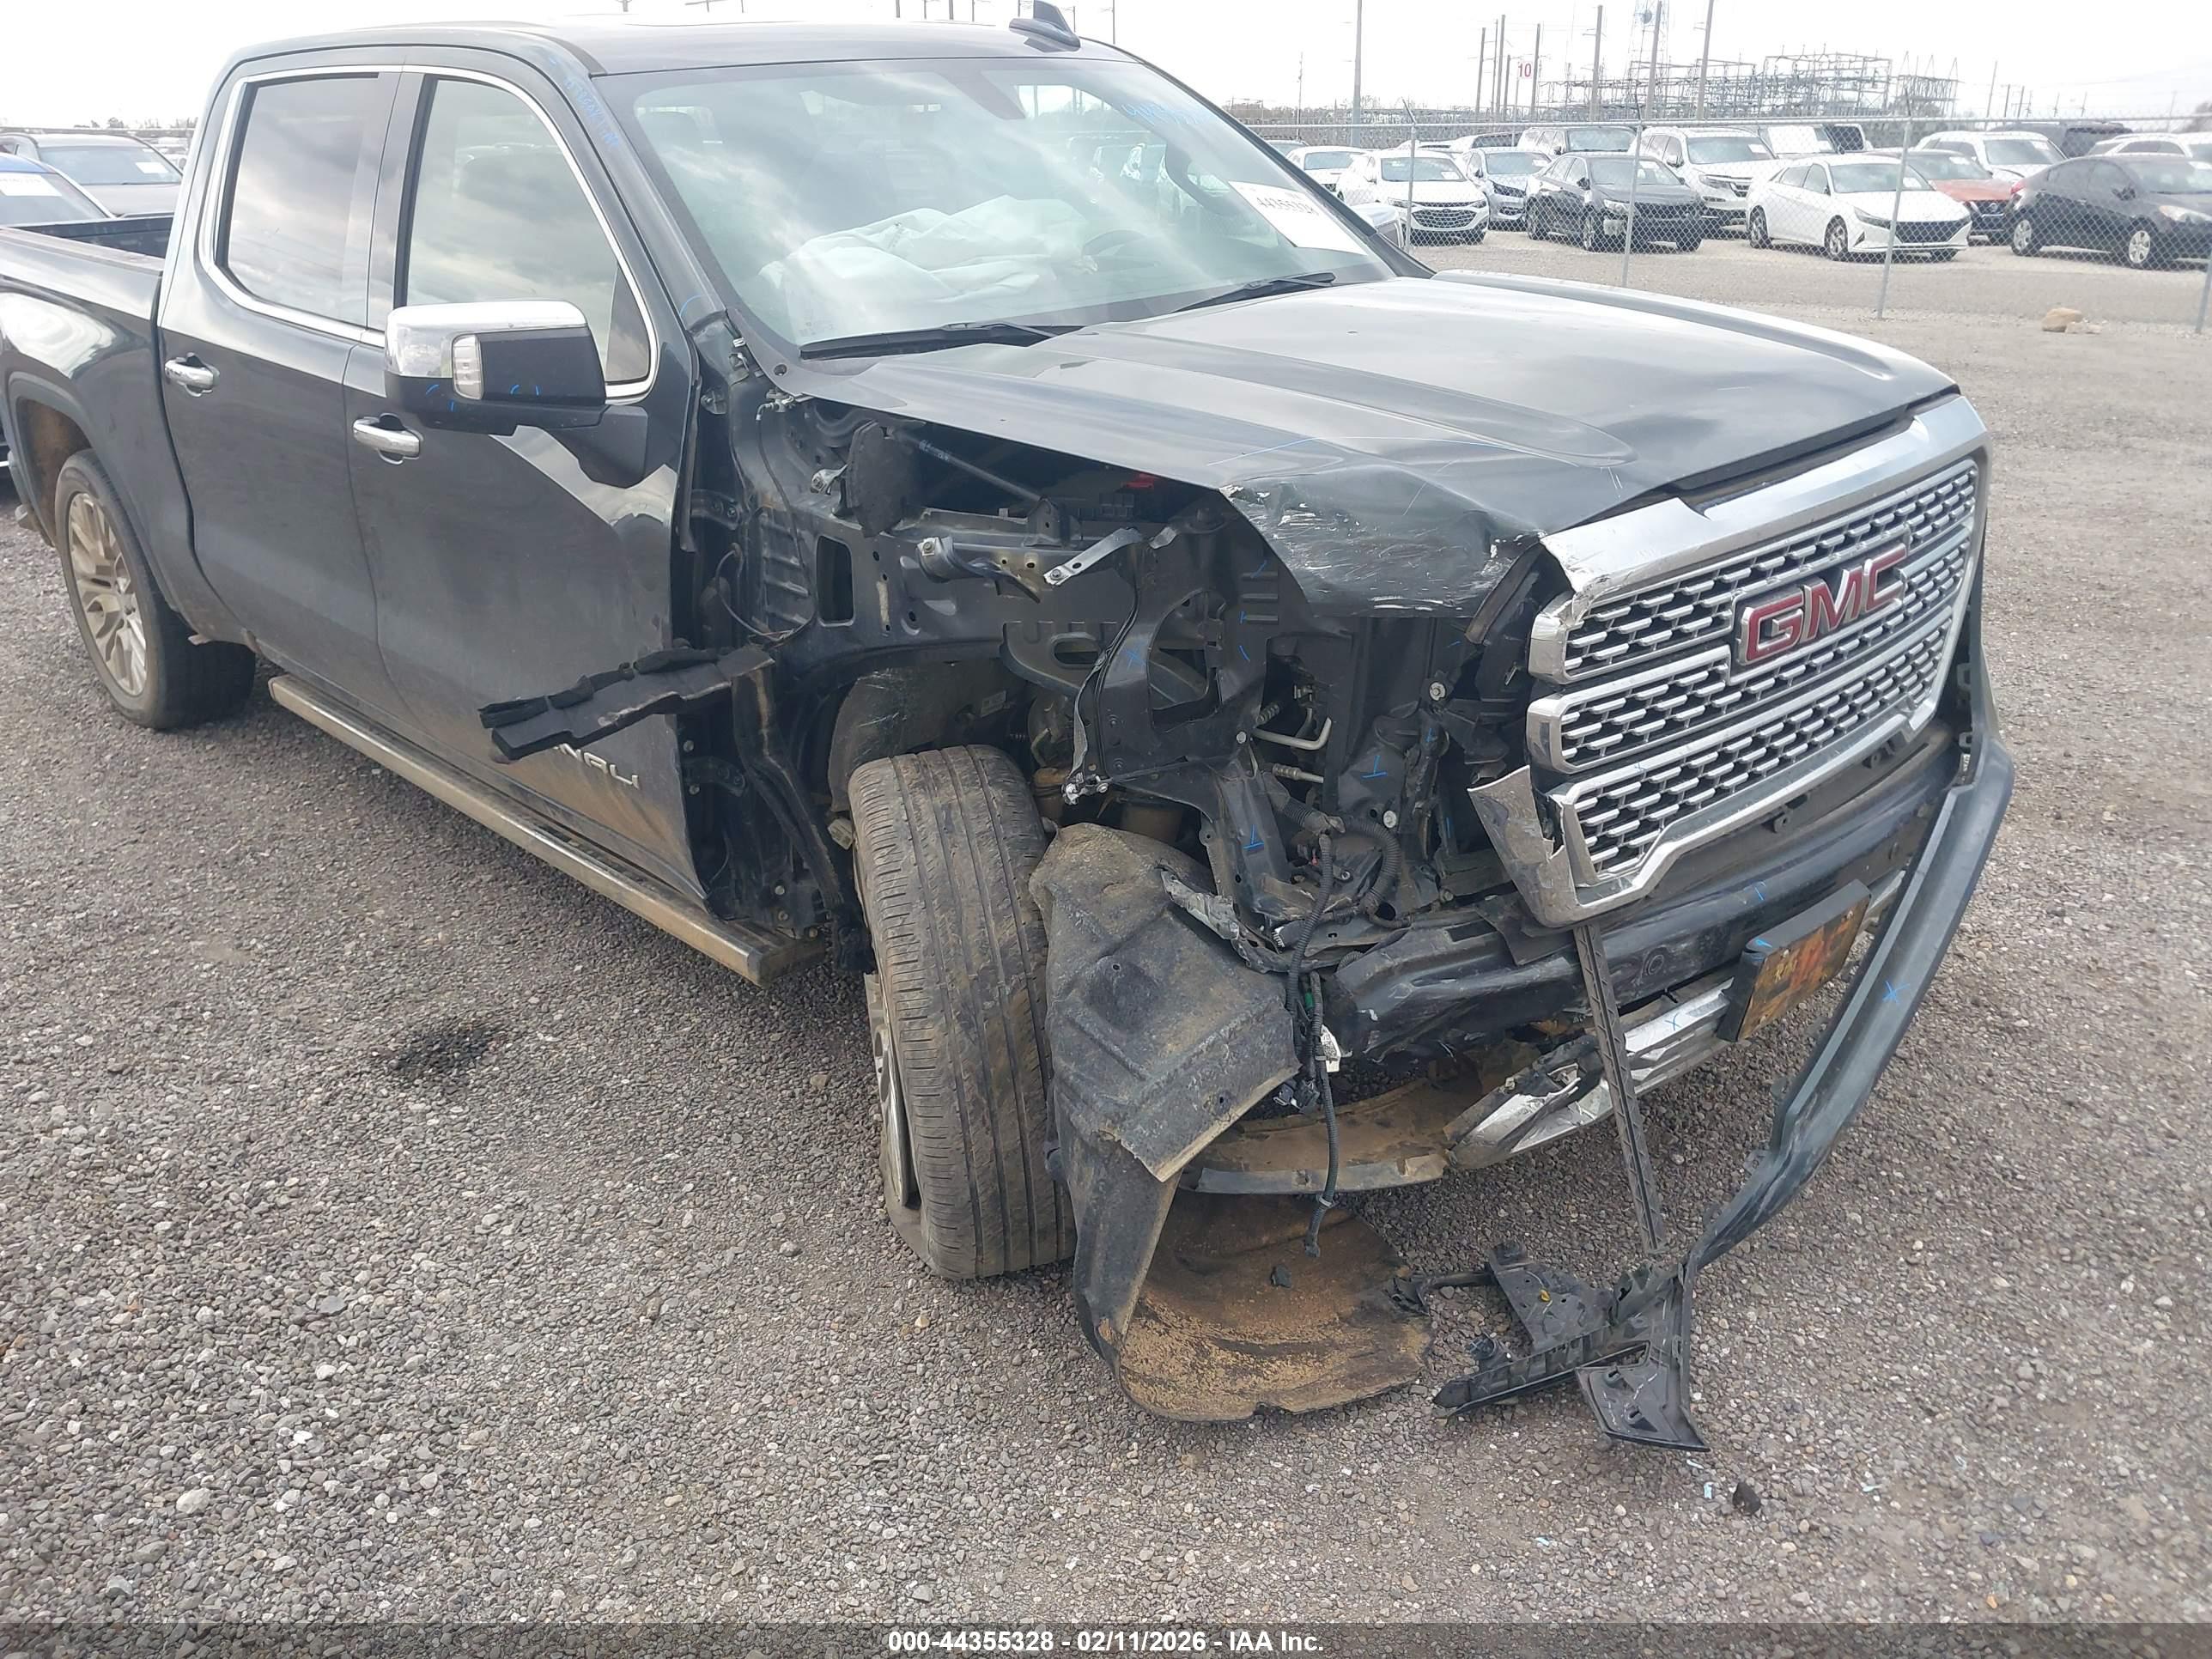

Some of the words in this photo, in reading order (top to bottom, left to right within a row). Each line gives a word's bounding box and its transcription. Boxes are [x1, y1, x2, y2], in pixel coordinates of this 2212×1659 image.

[1517, 63, 1532, 77] 10
[1741, 544, 1907, 665] GMC
[553, 743, 640, 790] NALI
